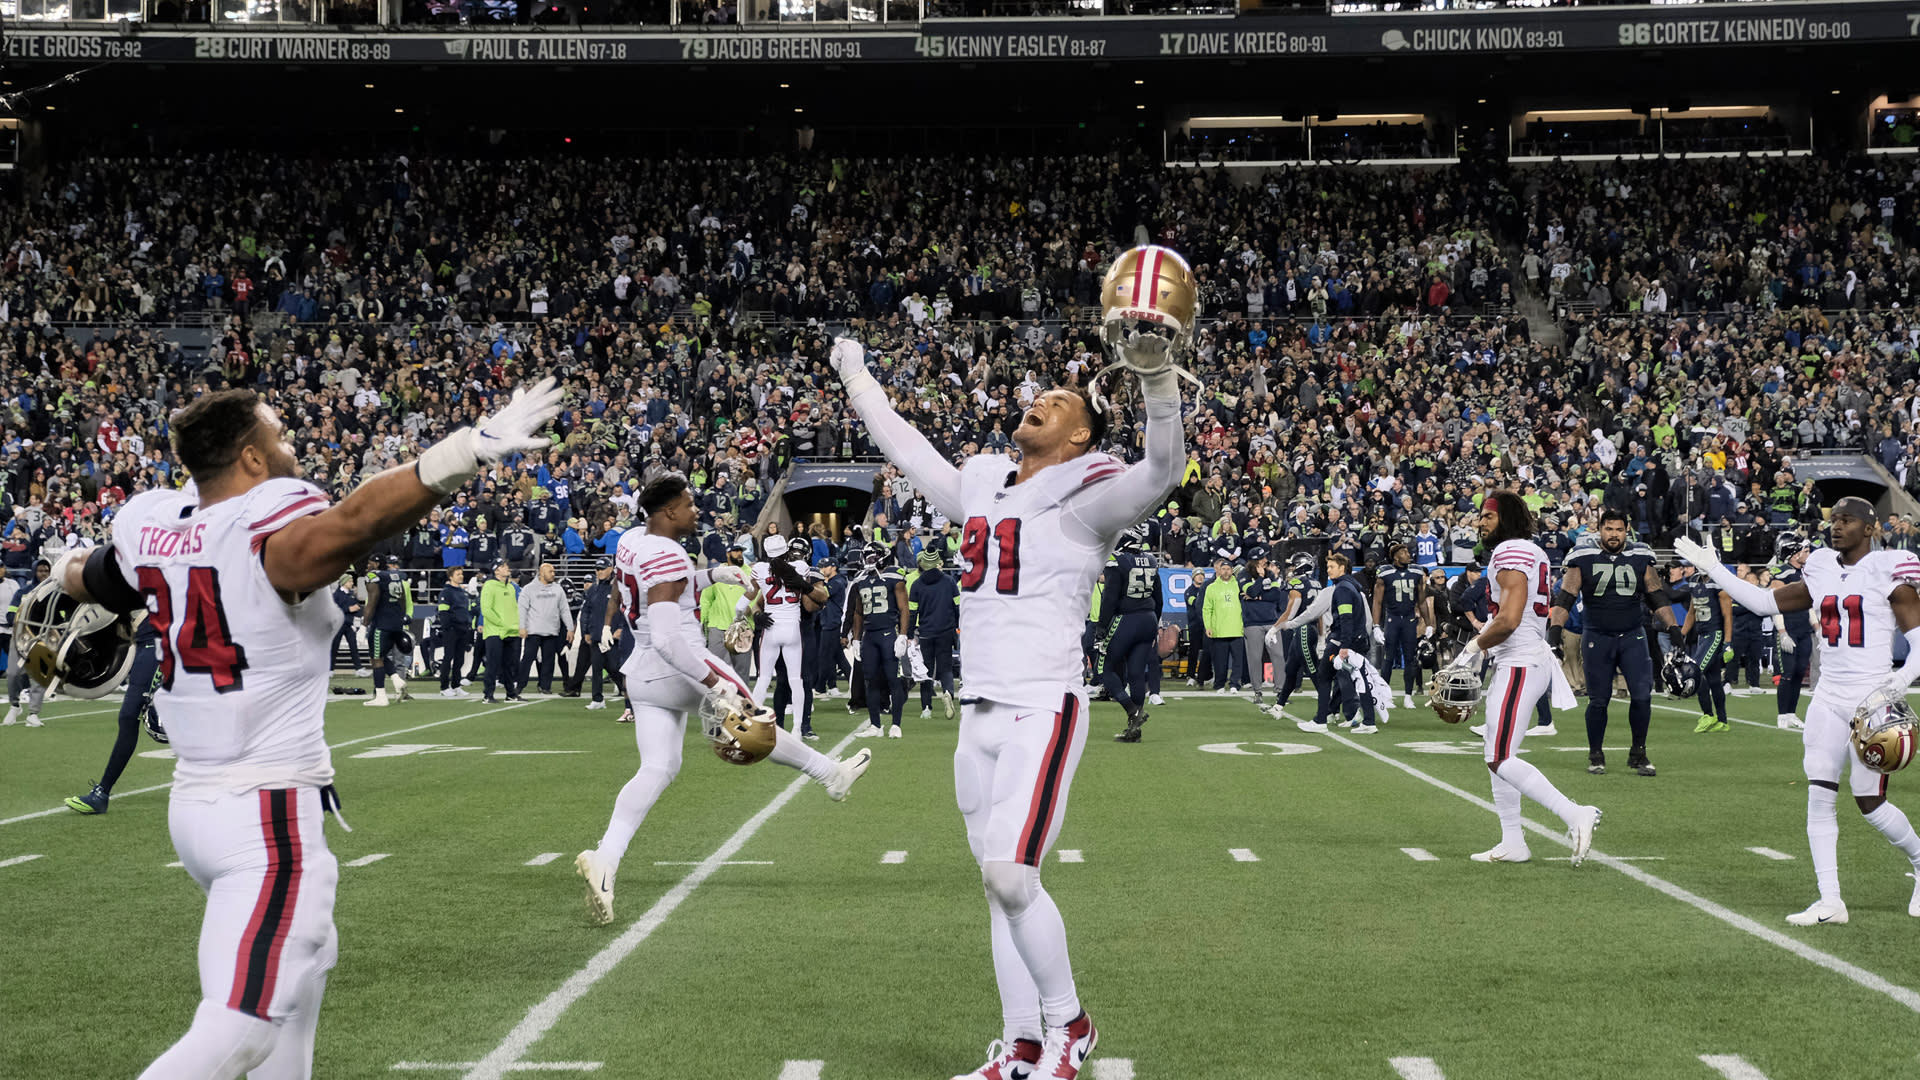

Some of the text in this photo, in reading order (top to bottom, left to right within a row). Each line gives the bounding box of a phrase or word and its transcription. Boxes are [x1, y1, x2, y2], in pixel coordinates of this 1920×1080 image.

[1619, 18, 1850, 45] 96 CORTEZ KENNEDY 90-00
[1907, 14, 1920, 36] 7
[44, 36, 101, 57] GROSS
[104, 41, 142, 58] 76-92
[195, 38, 390, 60] 28 CURT WARNER 83-89
[472, 39, 626, 60] PAUL G. ALLEN 97-18
[680, 38, 862, 59] 79 JACOB GREEN 80-91
[915, 35, 1106, 57] 45 KENNY EASLEY 81-87
[1160, 32, 1328, 54] 17 DAVE KRIEG 80-91
[1413, 27, 1564, 51] CHUCK KNOX 83-91
[1120, 310, 1164, 323] 49ERS
[1032, 330, 1040, 340] 3
[1731, 422, 1743, 432] 24
[1736, 456, 1747, 469] 10
[555, 485, 569, 499] 96
[899, 481, 910, 493] 12
[716, 495, 727, 509] 12
[32, 511, 41, 522] 3
[539, 507, 548, 519] 3
[1141, 522, 1149, 536] 3
[139, 523, 207, 558] THOAS
[479, 538, 488, 551] 3
[511, 533, 524, 547] 12
[1224, 536, 1235, 549] 3
[1417, 541, 1434, 556] 80
[960, 515, 1022, 596] 91
[1127, 567, 1158, 599] 65
[1391, 579, 1415, 602] 14
[1592, 563, 1638, 597] 70
[859, 585, 888, 615] 83
[135, 566, 250, 694] 94
[1820, 594, 1866, 648] 41
